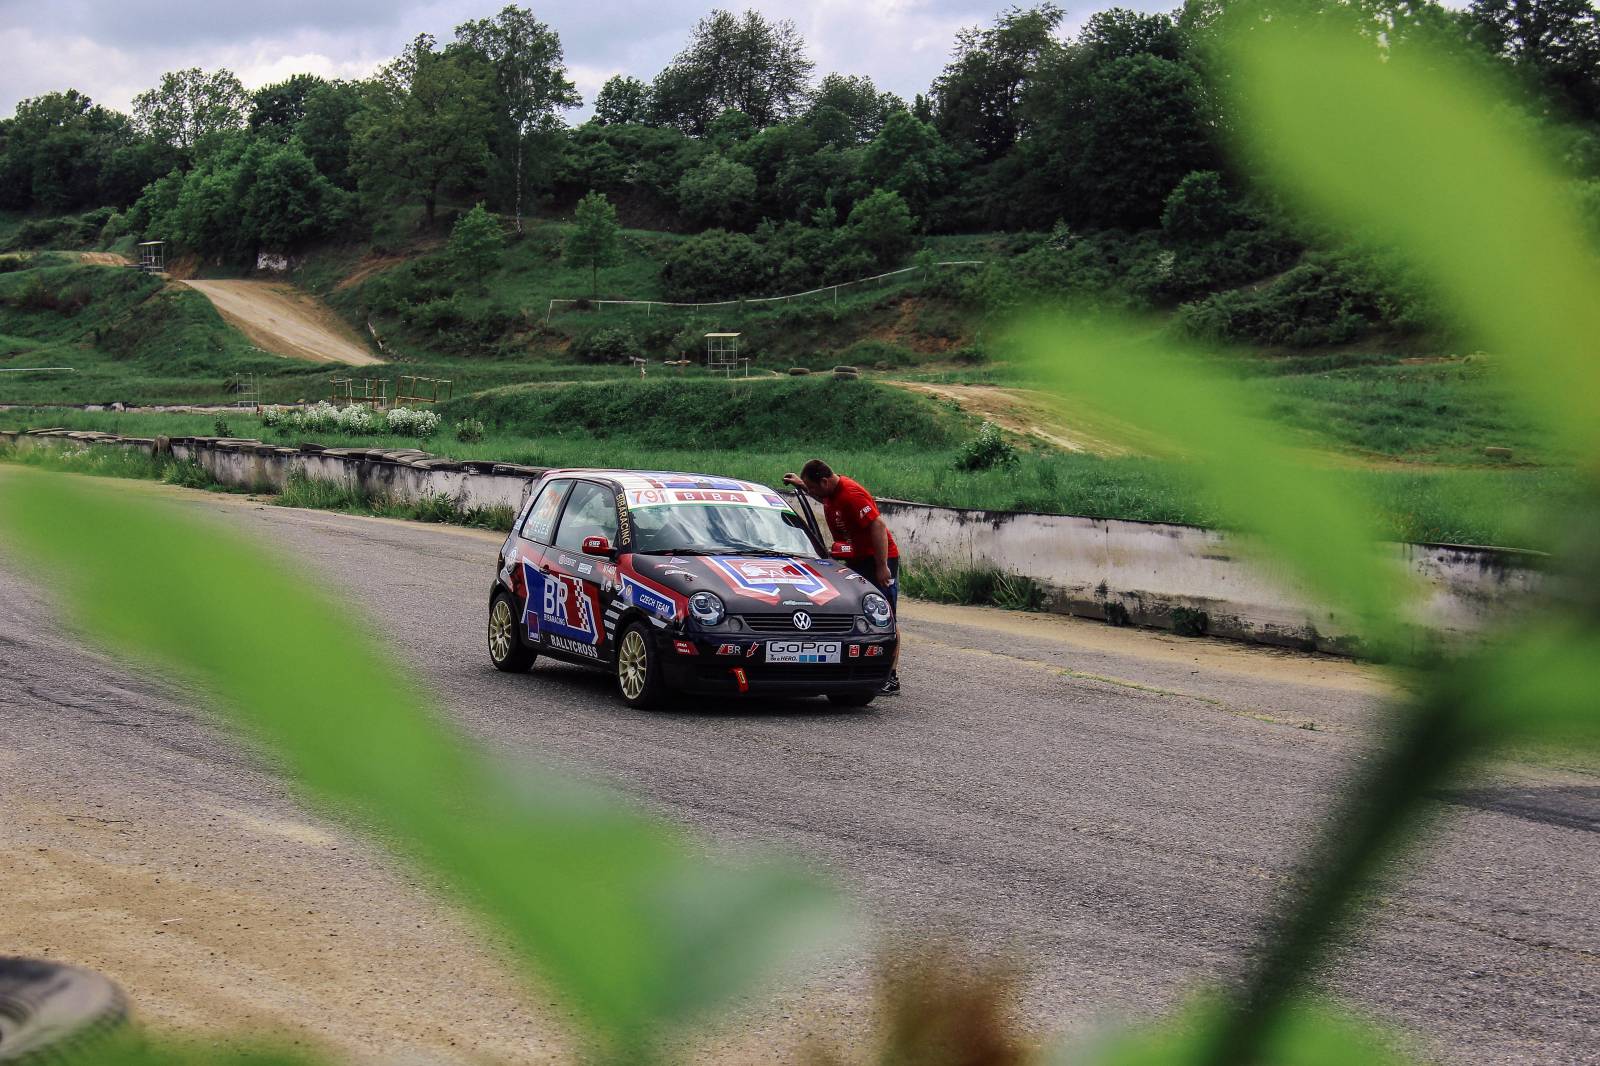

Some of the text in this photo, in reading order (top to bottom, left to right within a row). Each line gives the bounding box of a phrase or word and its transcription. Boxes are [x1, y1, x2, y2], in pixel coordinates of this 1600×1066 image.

[684, 492, 741, 501] BIBA
[616, 494, 630, 545] BIBARACING
[544, 578, 568, 620] BR
[640, 594, 656, 608] CZECH
[655, 600, 670, 613] TEAM
[550, 634, 598, 658] RALLYCROSS
[769, 642, 837, 653] GoPro
